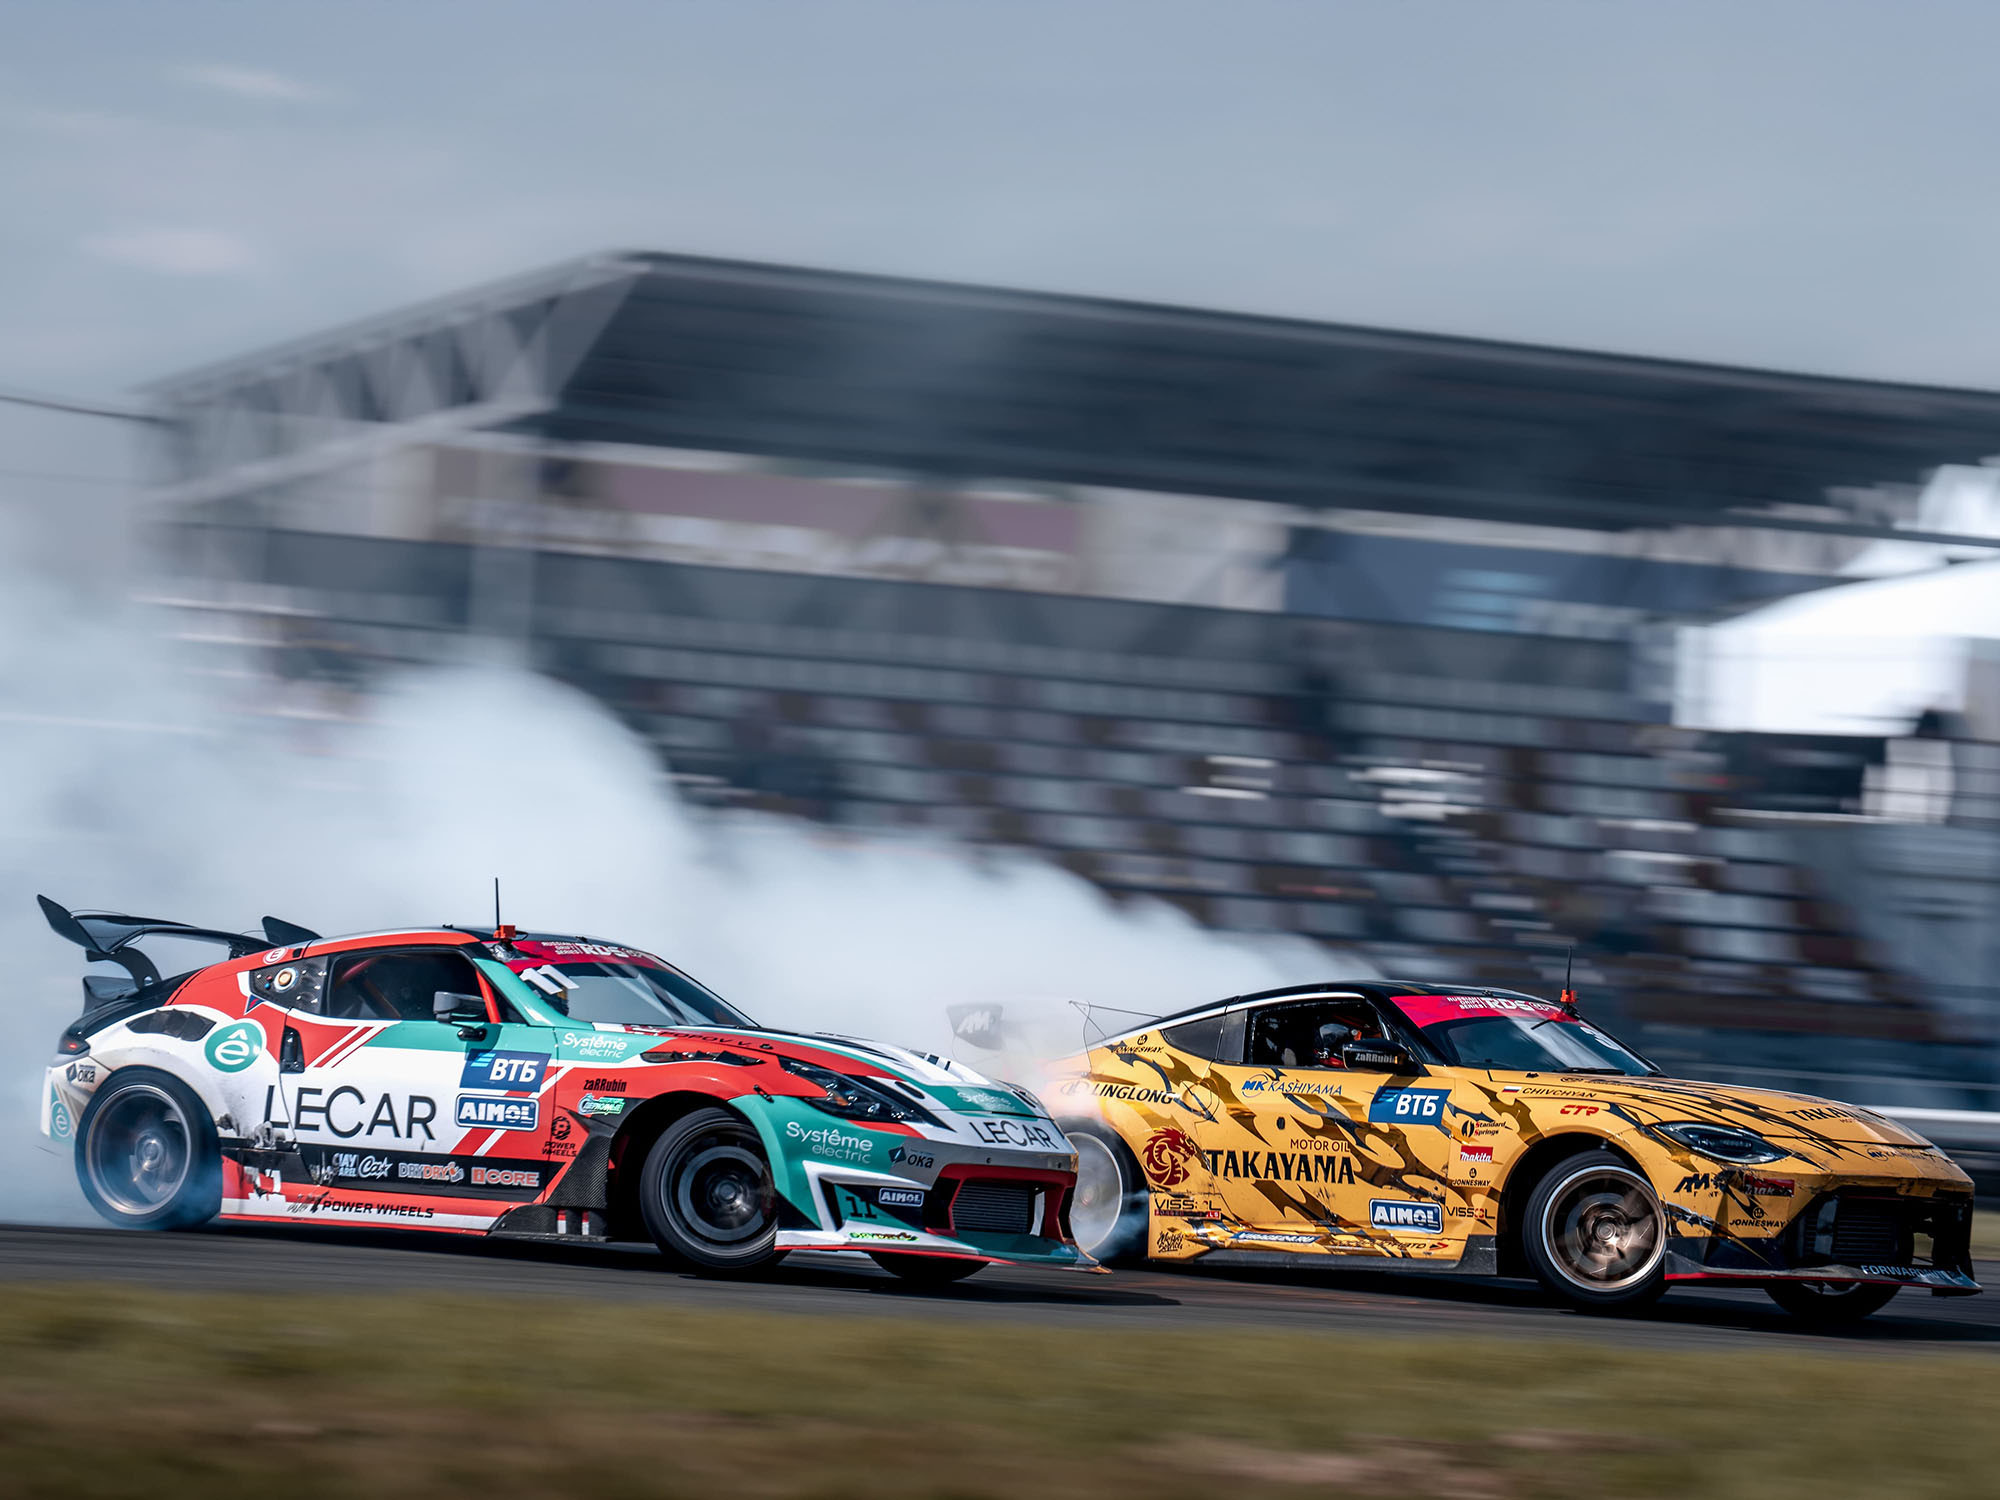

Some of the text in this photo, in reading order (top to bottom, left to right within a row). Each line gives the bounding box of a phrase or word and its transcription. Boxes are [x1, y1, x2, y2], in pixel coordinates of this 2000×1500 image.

[576, 943, 629, 958] RDS
[519, 964, 579, 995] 11
[1480, 997, 1535, 1012] RDS
[579, 1047, 624, 1058] electric
[489, 1058, 540, 1083] ВТБ
[1091, 1083, 1174, 1104] LINGLONG
[1268, 1081, 1342, 1095] KASHIYAMA
[1522, 1087, 1597, 1098] CHIVCHYAN
[264, 1084, 435, 1139] LECAR
[1395, 1094, 1440, 1117] ВТБ
[969, 1120, 1059, 1149] LECAR
[542, 1149, 577, 1157] WHEELS
[545, 1141, 576, 1149] POWER
[1290, 1139, 1350, 1152] MOTOR OIL
[811, 1144, 872, 1165] electric
[1206, 1149, 1356, 1184] TAKAYAMA
[1452, 1179, 1491, 1187] JONNESWAY
[322, 1200, 373, 1214] POWER
[376, 1204, 435, 1218] WHEELS
[846, 1196, 877, 1219] 11
[1446, 1206, 1496, 1220] VISSOL
[1373, 1206, 1439, 1227] AIMOL
[1729, 1219, 1786, 1228] JONNESWAY
